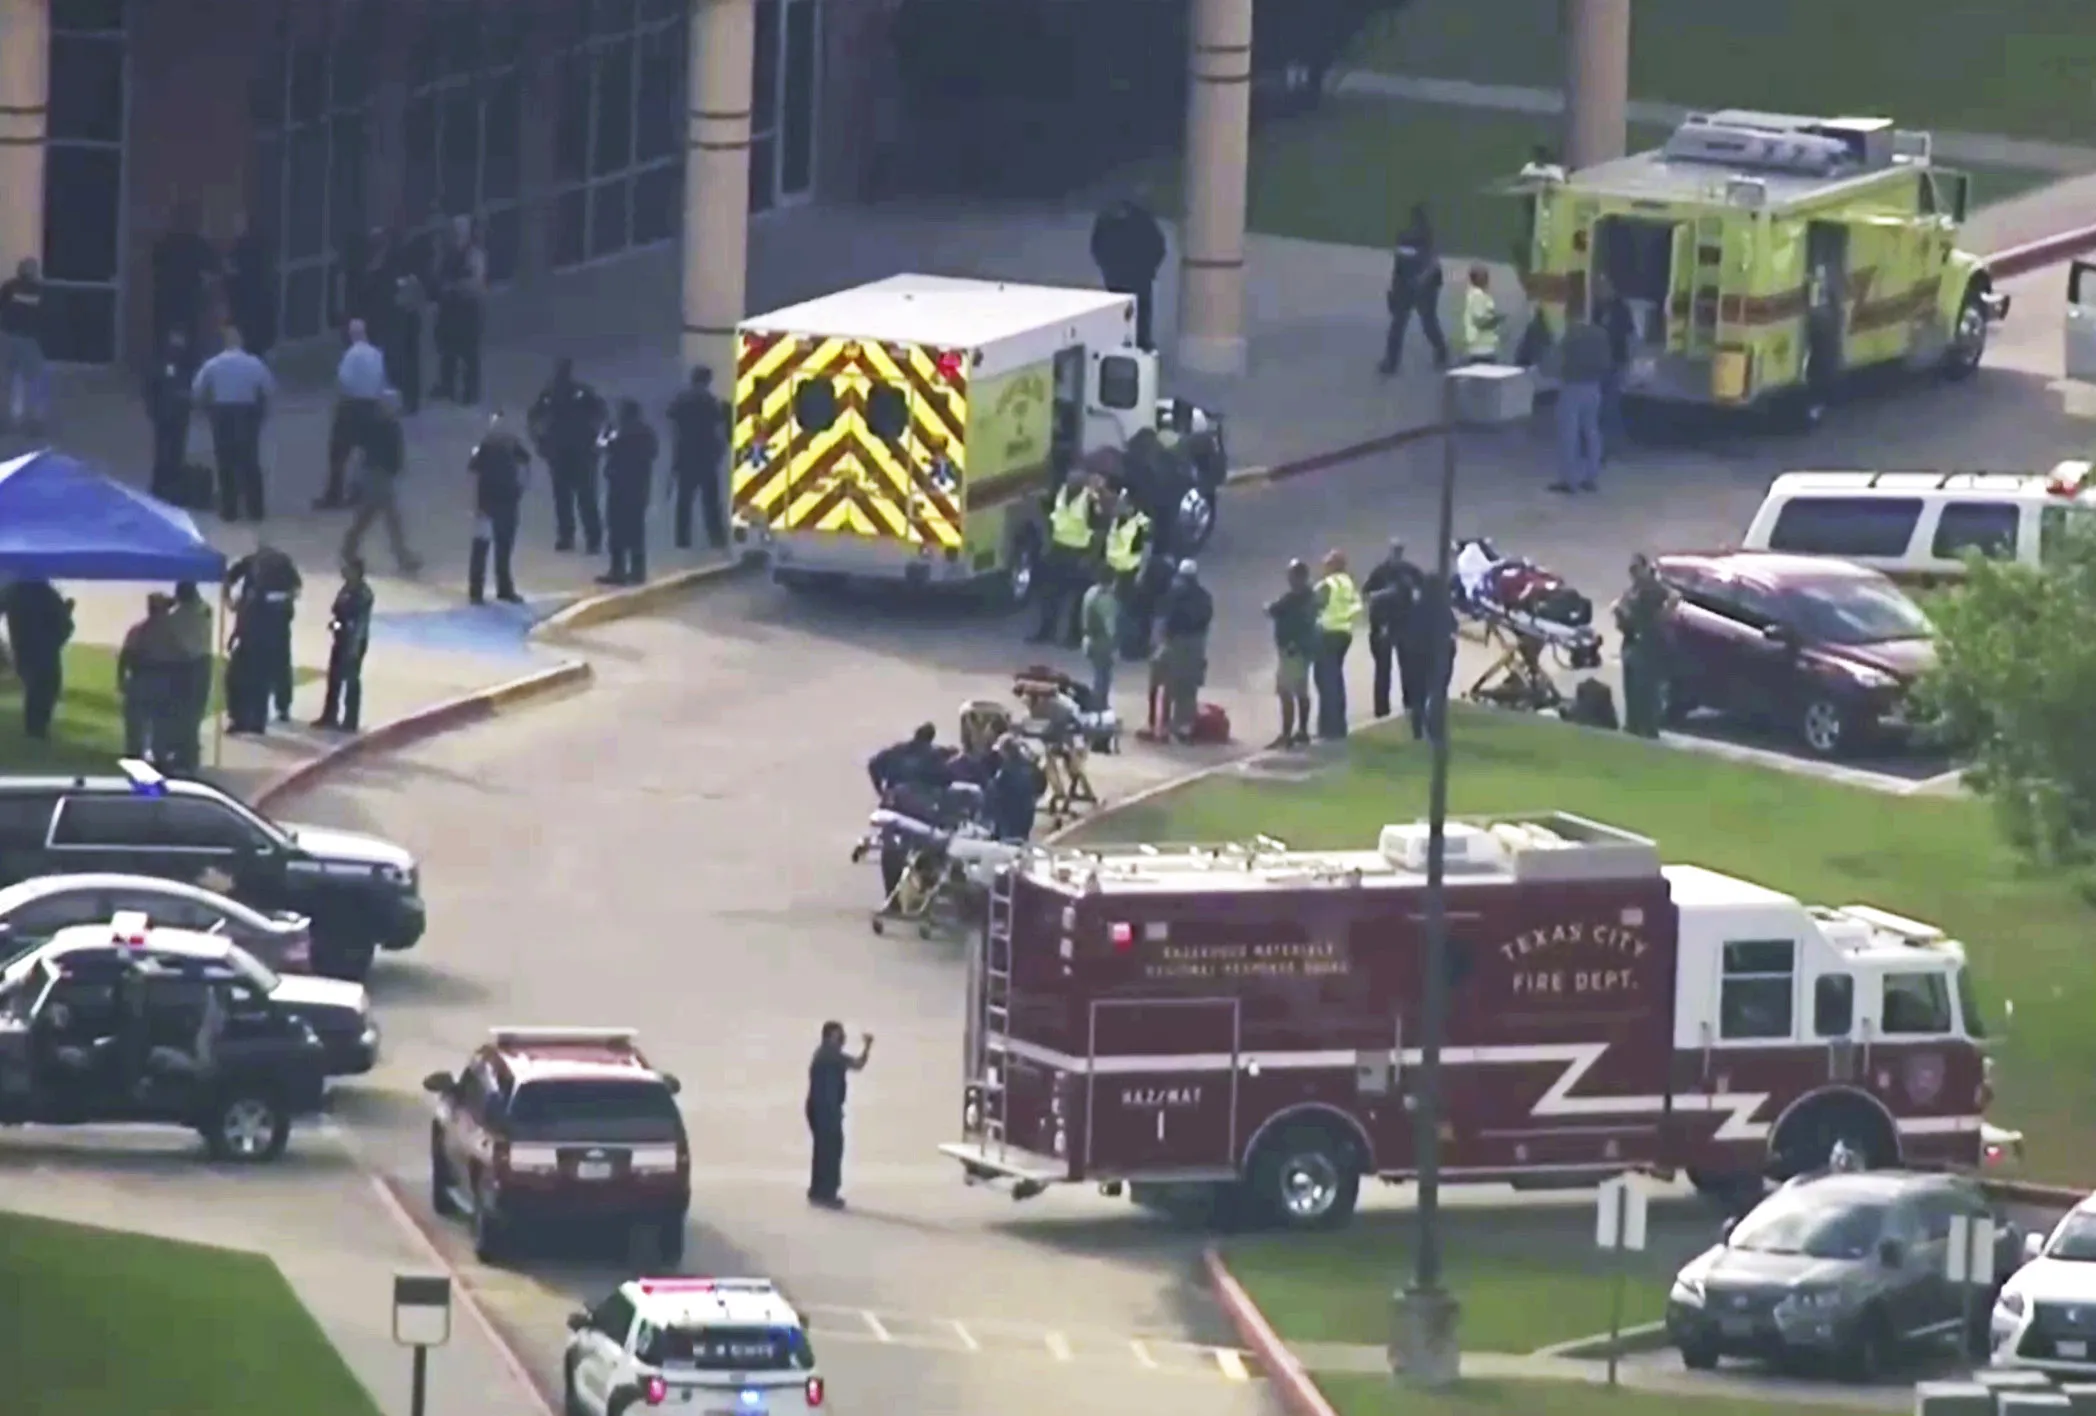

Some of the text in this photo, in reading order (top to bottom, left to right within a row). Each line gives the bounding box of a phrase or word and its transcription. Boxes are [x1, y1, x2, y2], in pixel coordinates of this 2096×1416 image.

[1500, 922, 1648, 961] TEXAS CITY
[1512, 968, 1638, 993] FIRE DEPT.
